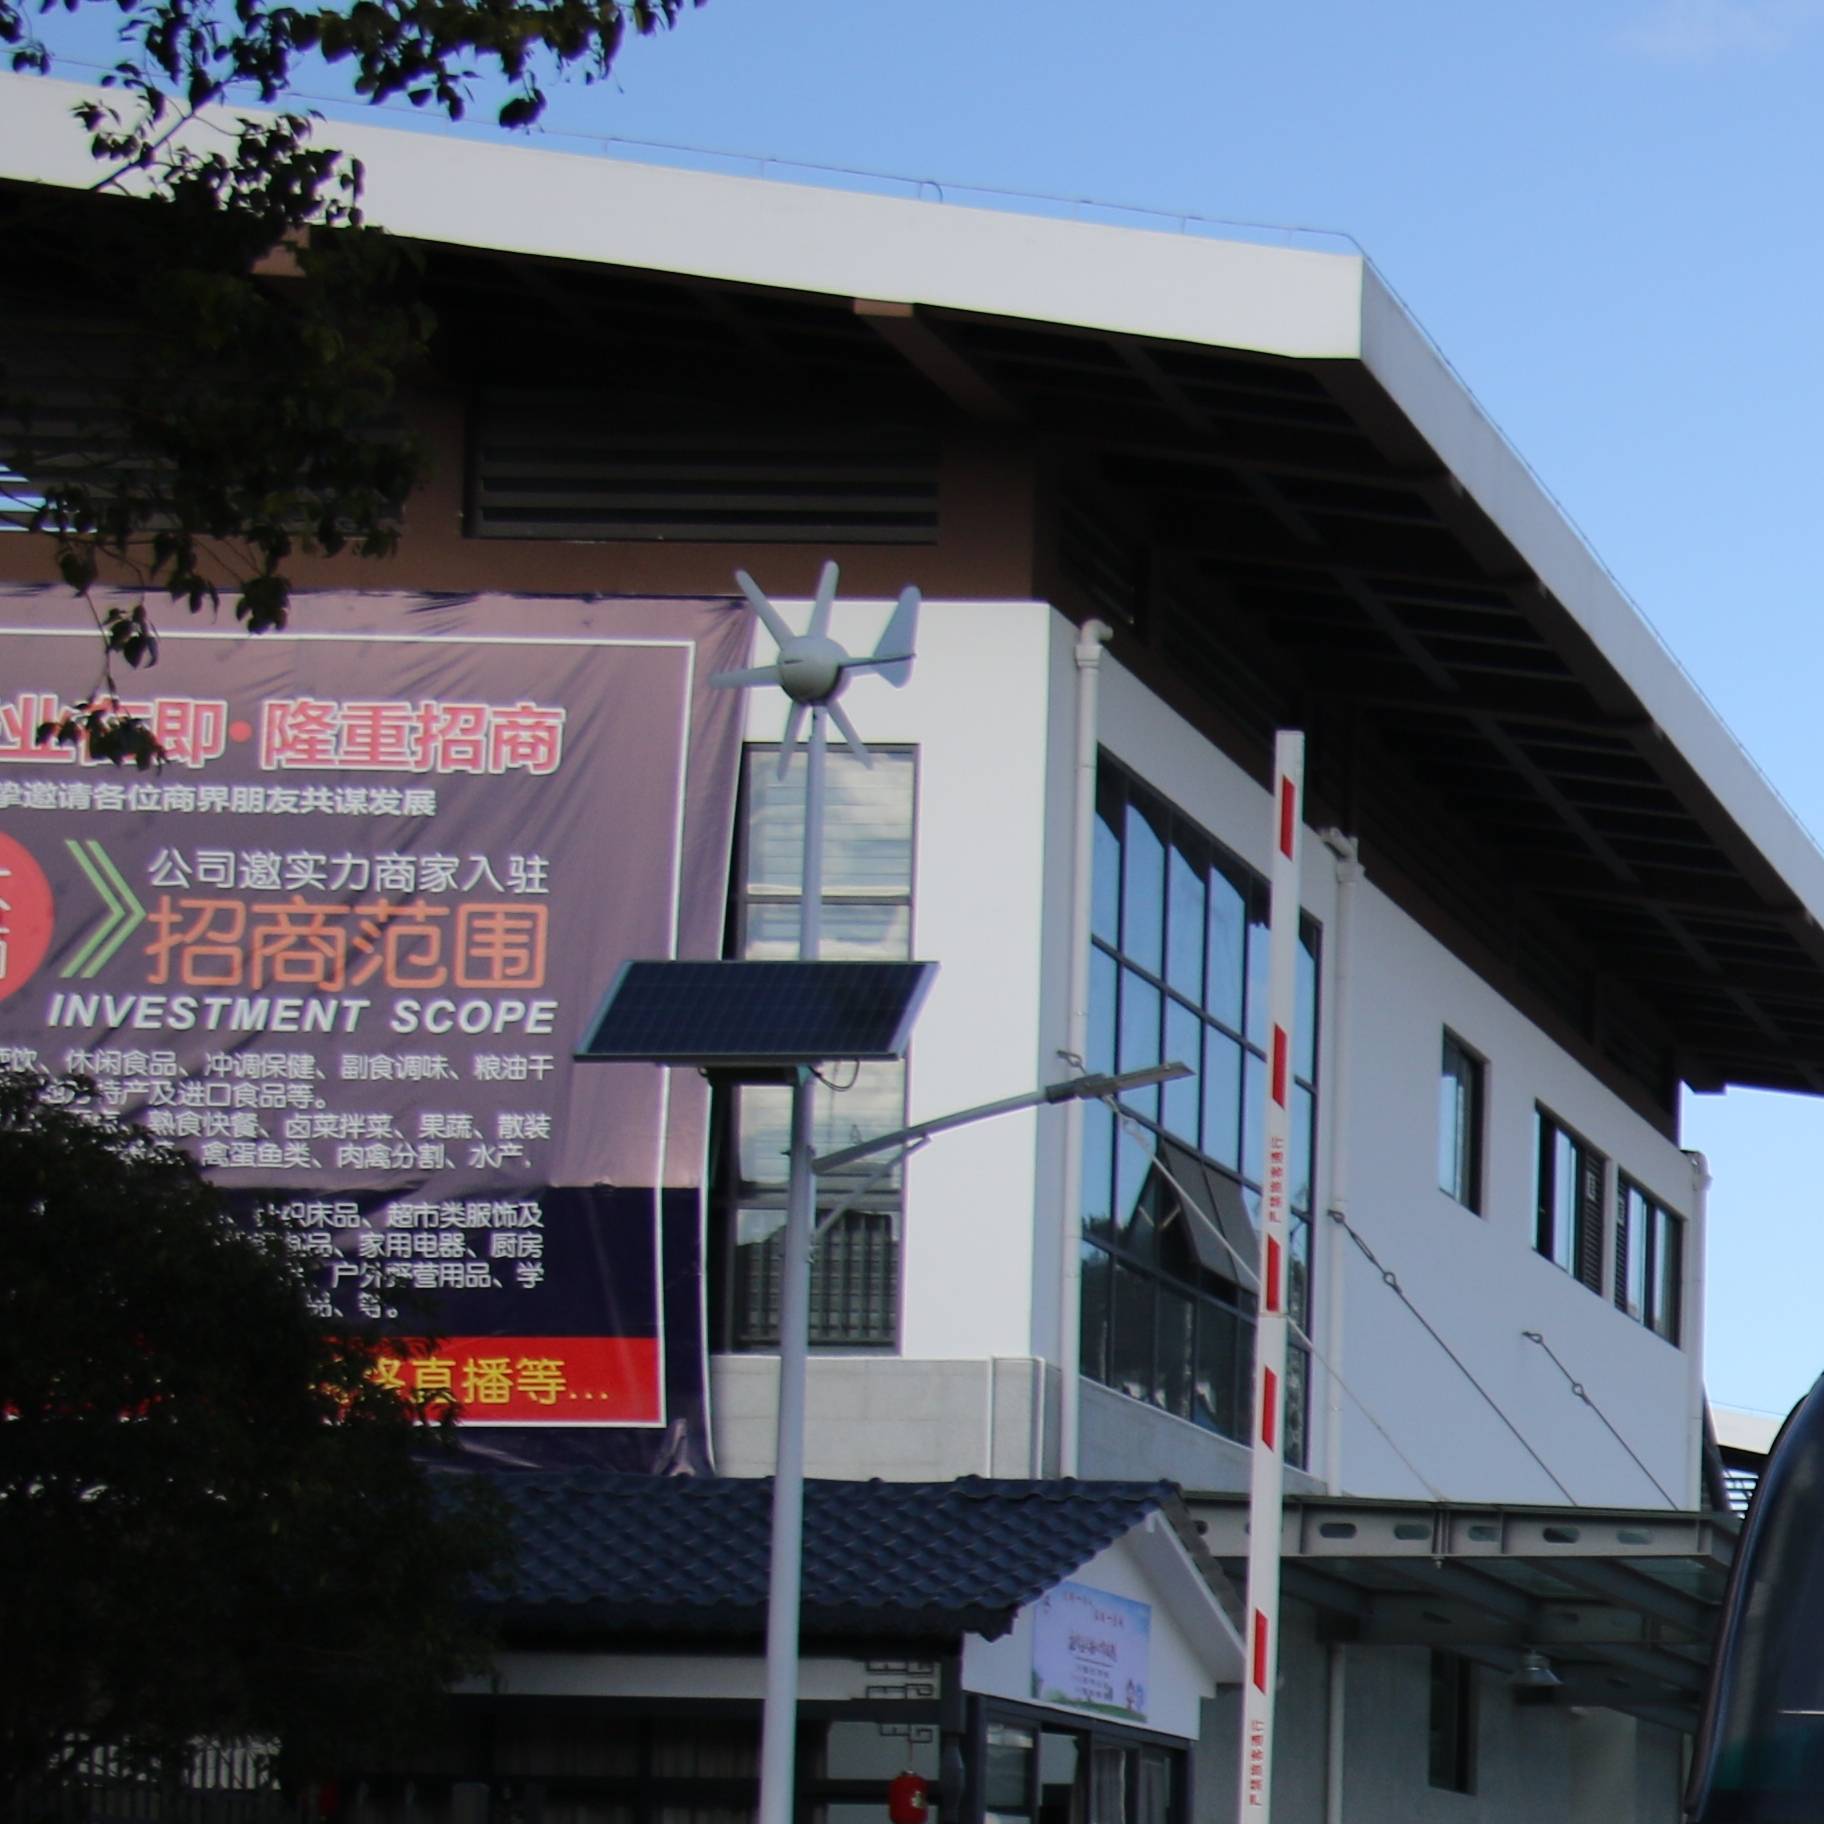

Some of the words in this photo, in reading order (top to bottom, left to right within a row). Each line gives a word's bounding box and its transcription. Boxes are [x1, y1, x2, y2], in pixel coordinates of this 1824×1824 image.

[148, 848, 550, 895] 公司邀实力商家入驻
[144, 895, 549, 992] 招商范围
[47, 994, 371, 1034] INVESTMENT
[390, 998, 559, 1036] SCOPE
